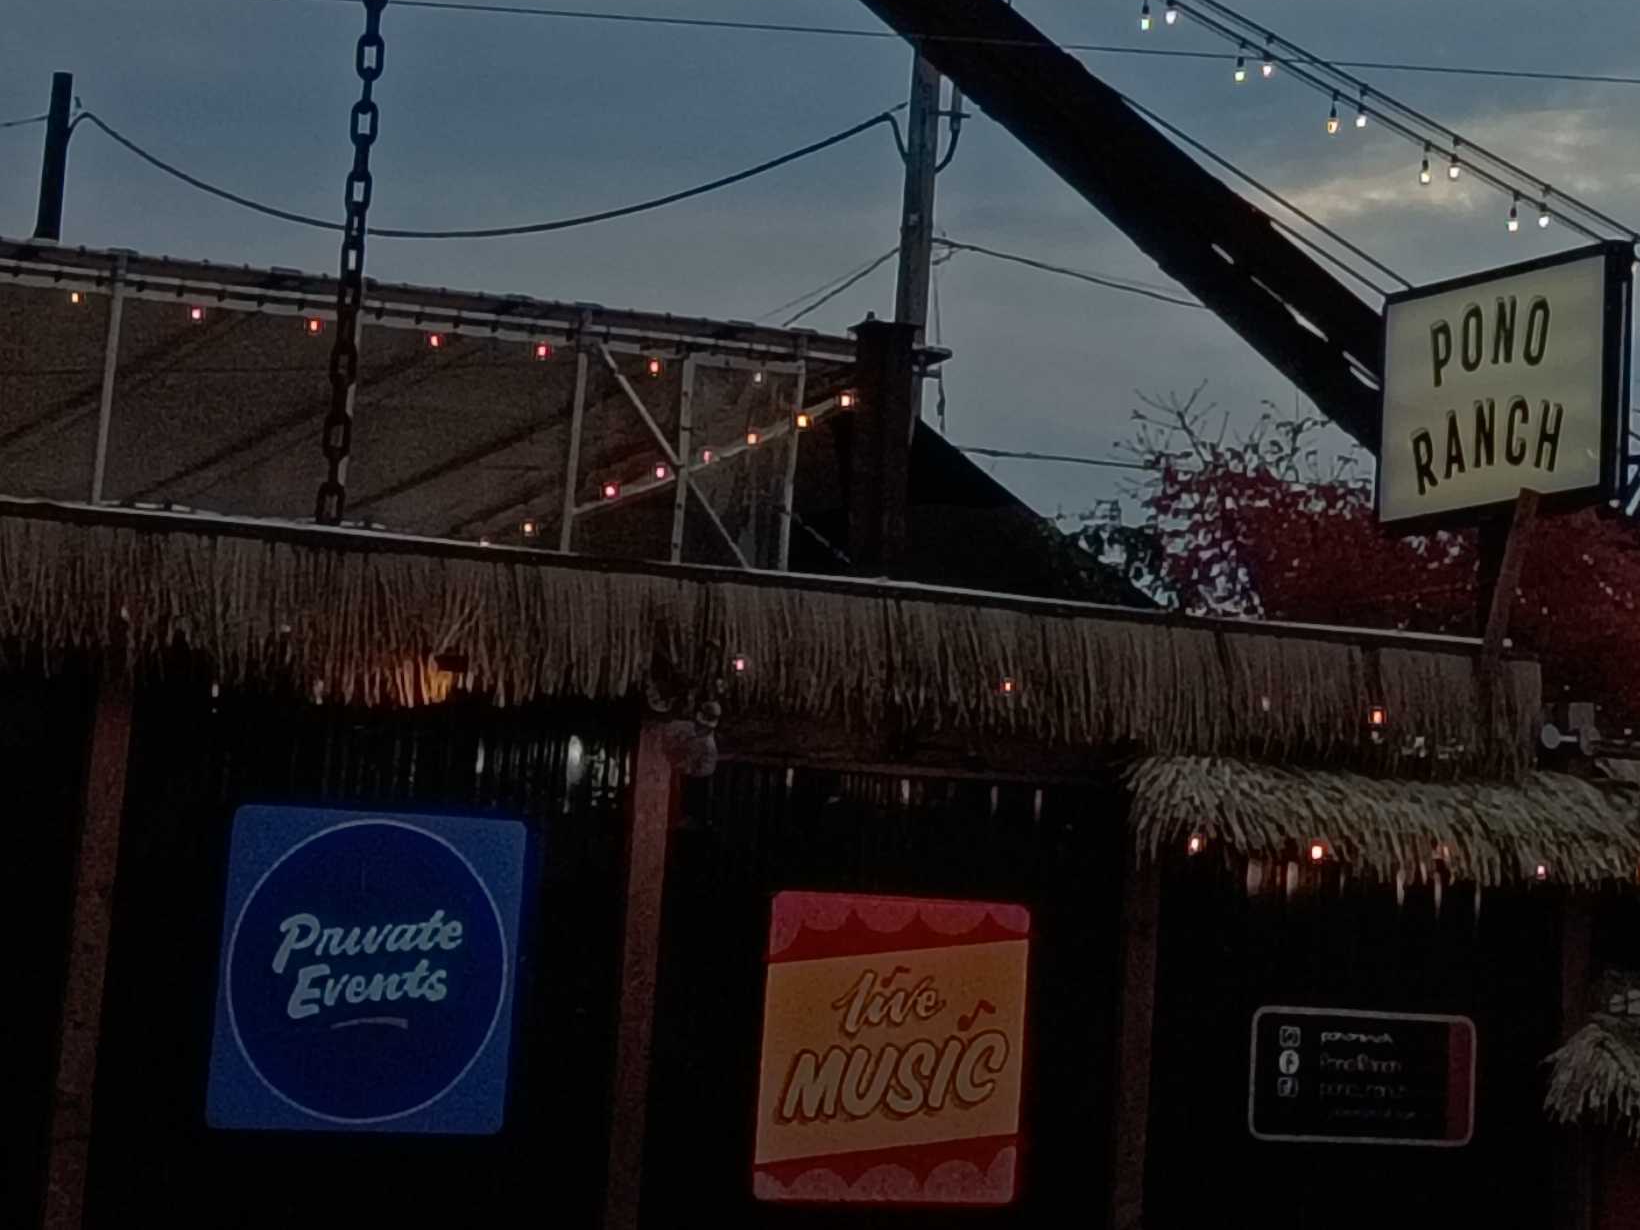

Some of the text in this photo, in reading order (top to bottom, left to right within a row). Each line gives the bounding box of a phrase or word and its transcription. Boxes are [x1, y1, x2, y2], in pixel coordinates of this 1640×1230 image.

[1430, 294, 1550, 388] PONO
[1410, 394, 1563, 496] RANCH
[272, 909, 464, 975] Private
[287, 958, 448, 1020] Events
[779, 1029, 1009, 1123] MUSIC
